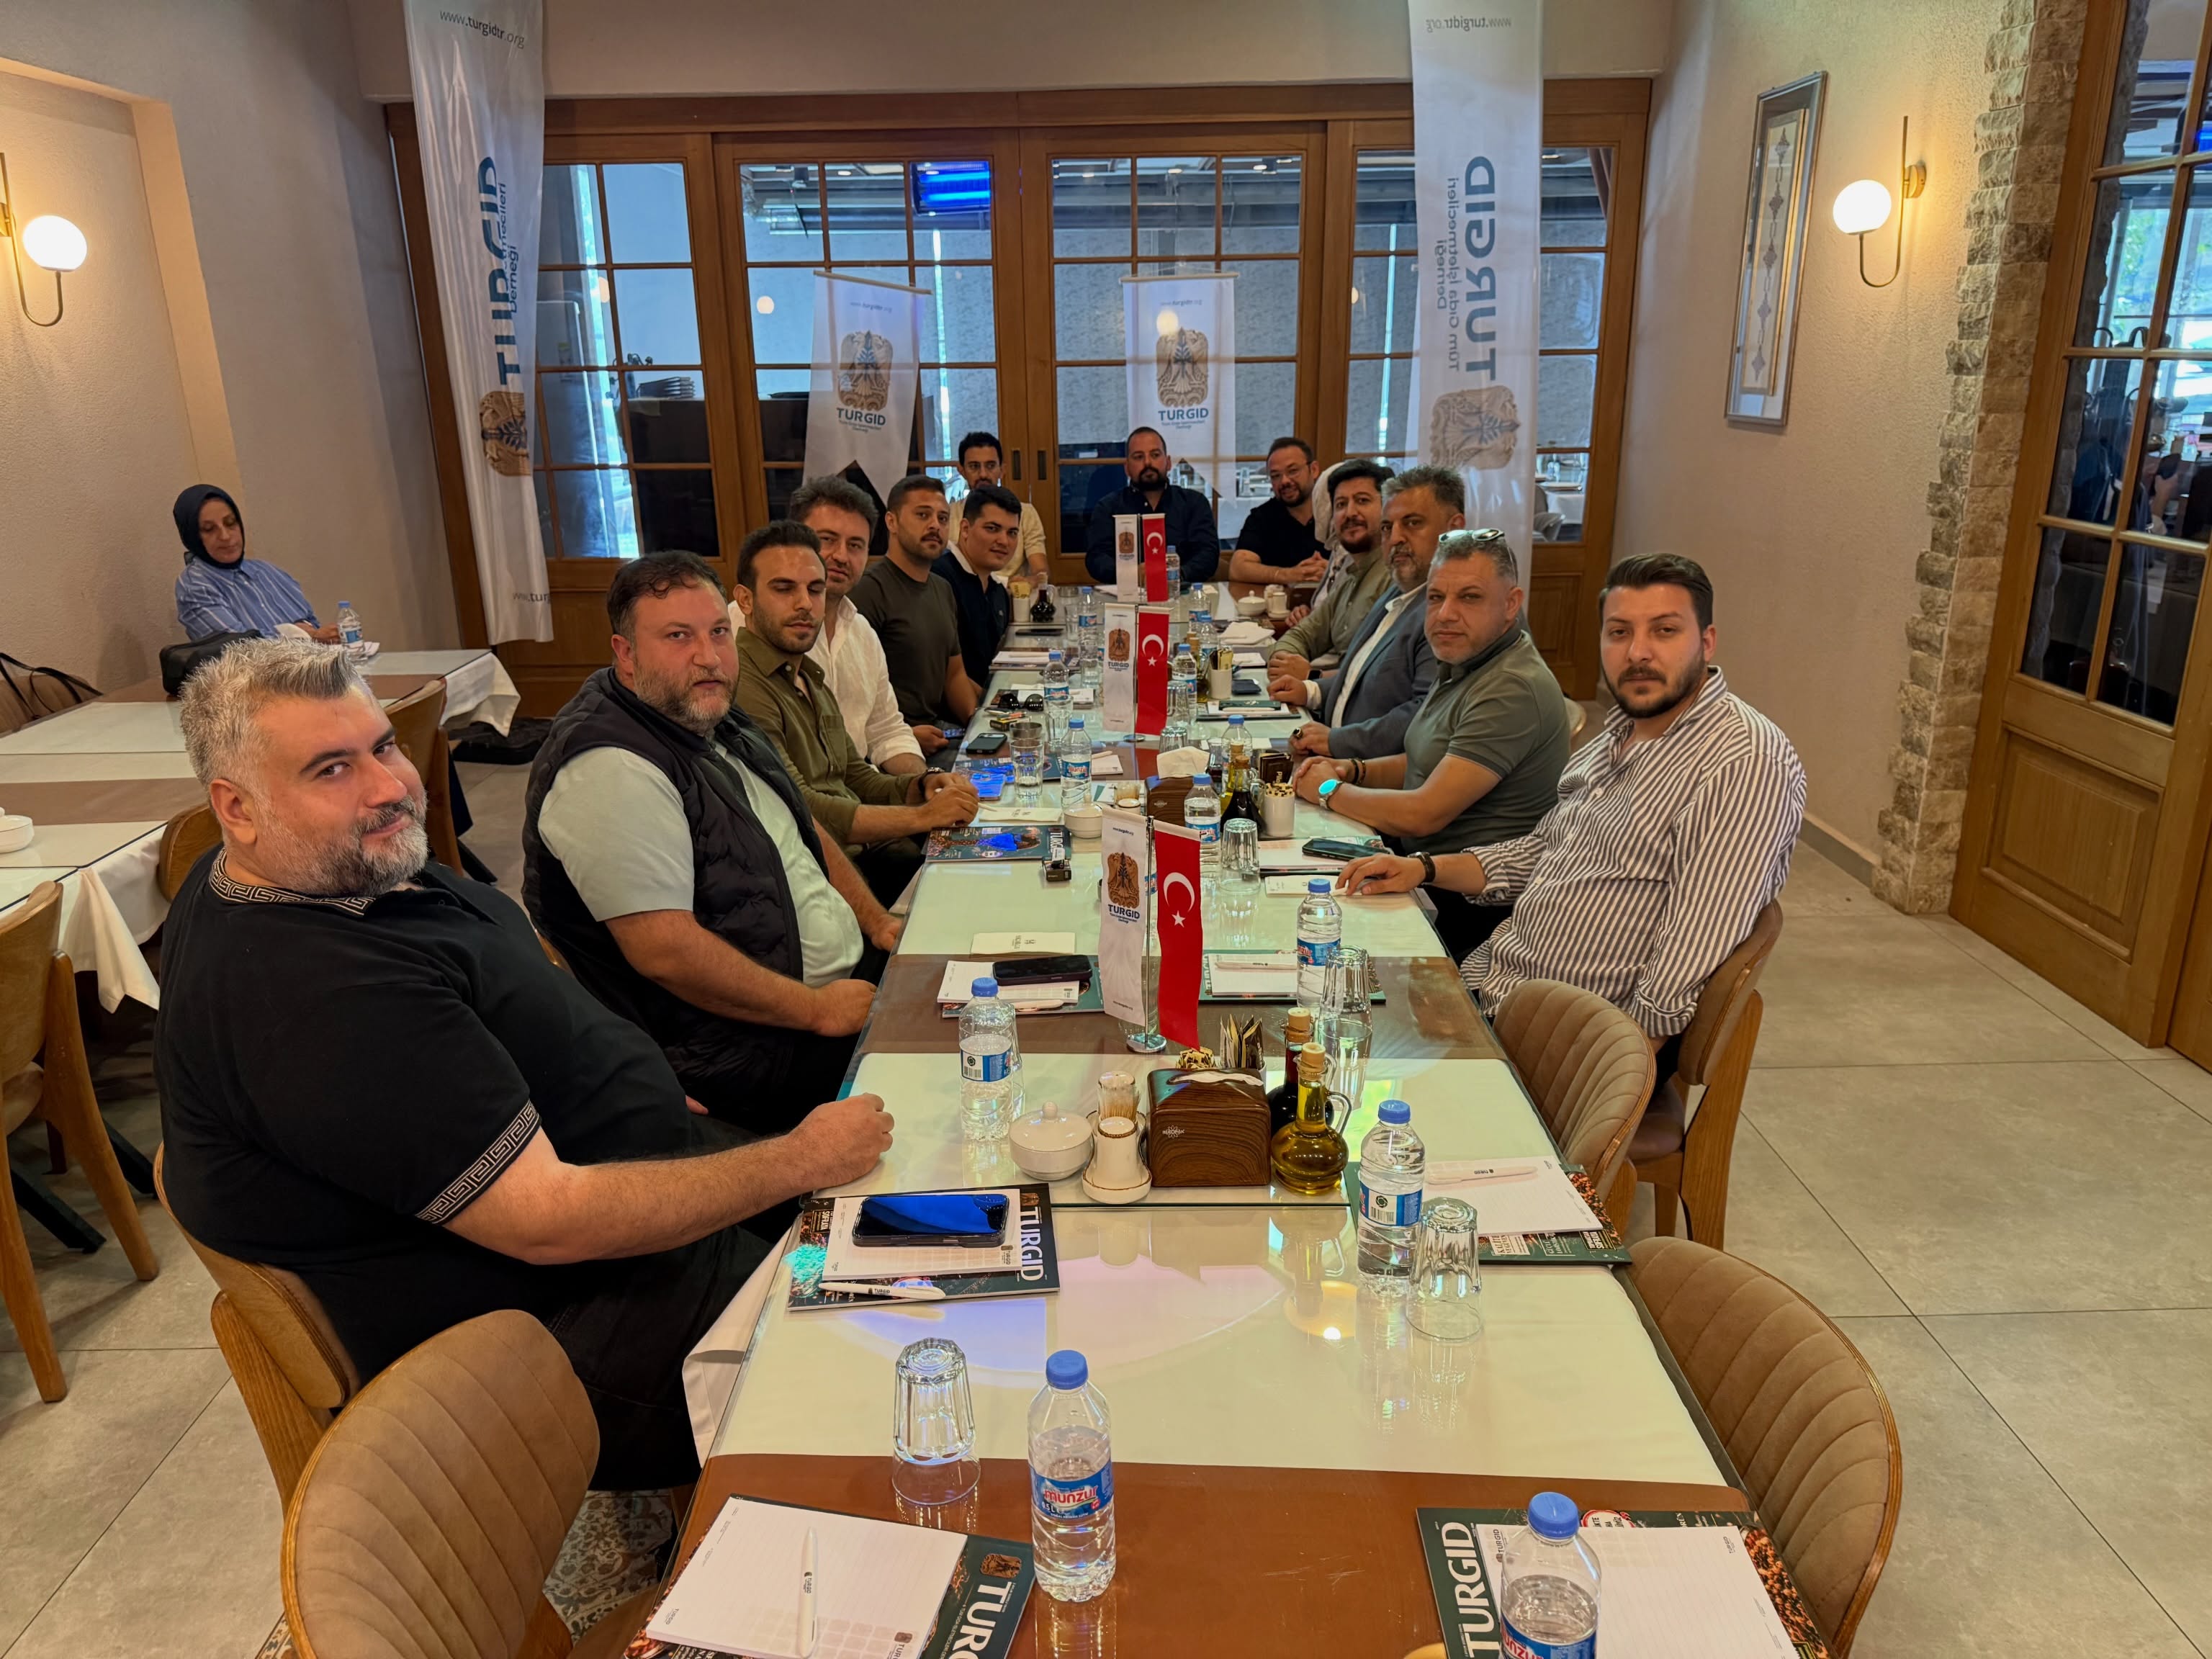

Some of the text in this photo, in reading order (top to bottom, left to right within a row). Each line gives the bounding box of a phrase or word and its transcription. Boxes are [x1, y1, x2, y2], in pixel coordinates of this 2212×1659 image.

[440, 11, 524, 49] www.turgidtr.org
[837, 408, 886, 426] TURGID
[1158, 408, 1209, 421] TURGID
[1107, 904, 1140, 920] TURGID
[1020, 1207, 1044, 1281] TURGID
[1043, 1485, 1098, 1503] munzur
[1493, 1529, 1503, 1554] TURGID
[1442, 1522, 1501, 1658] TURGID
